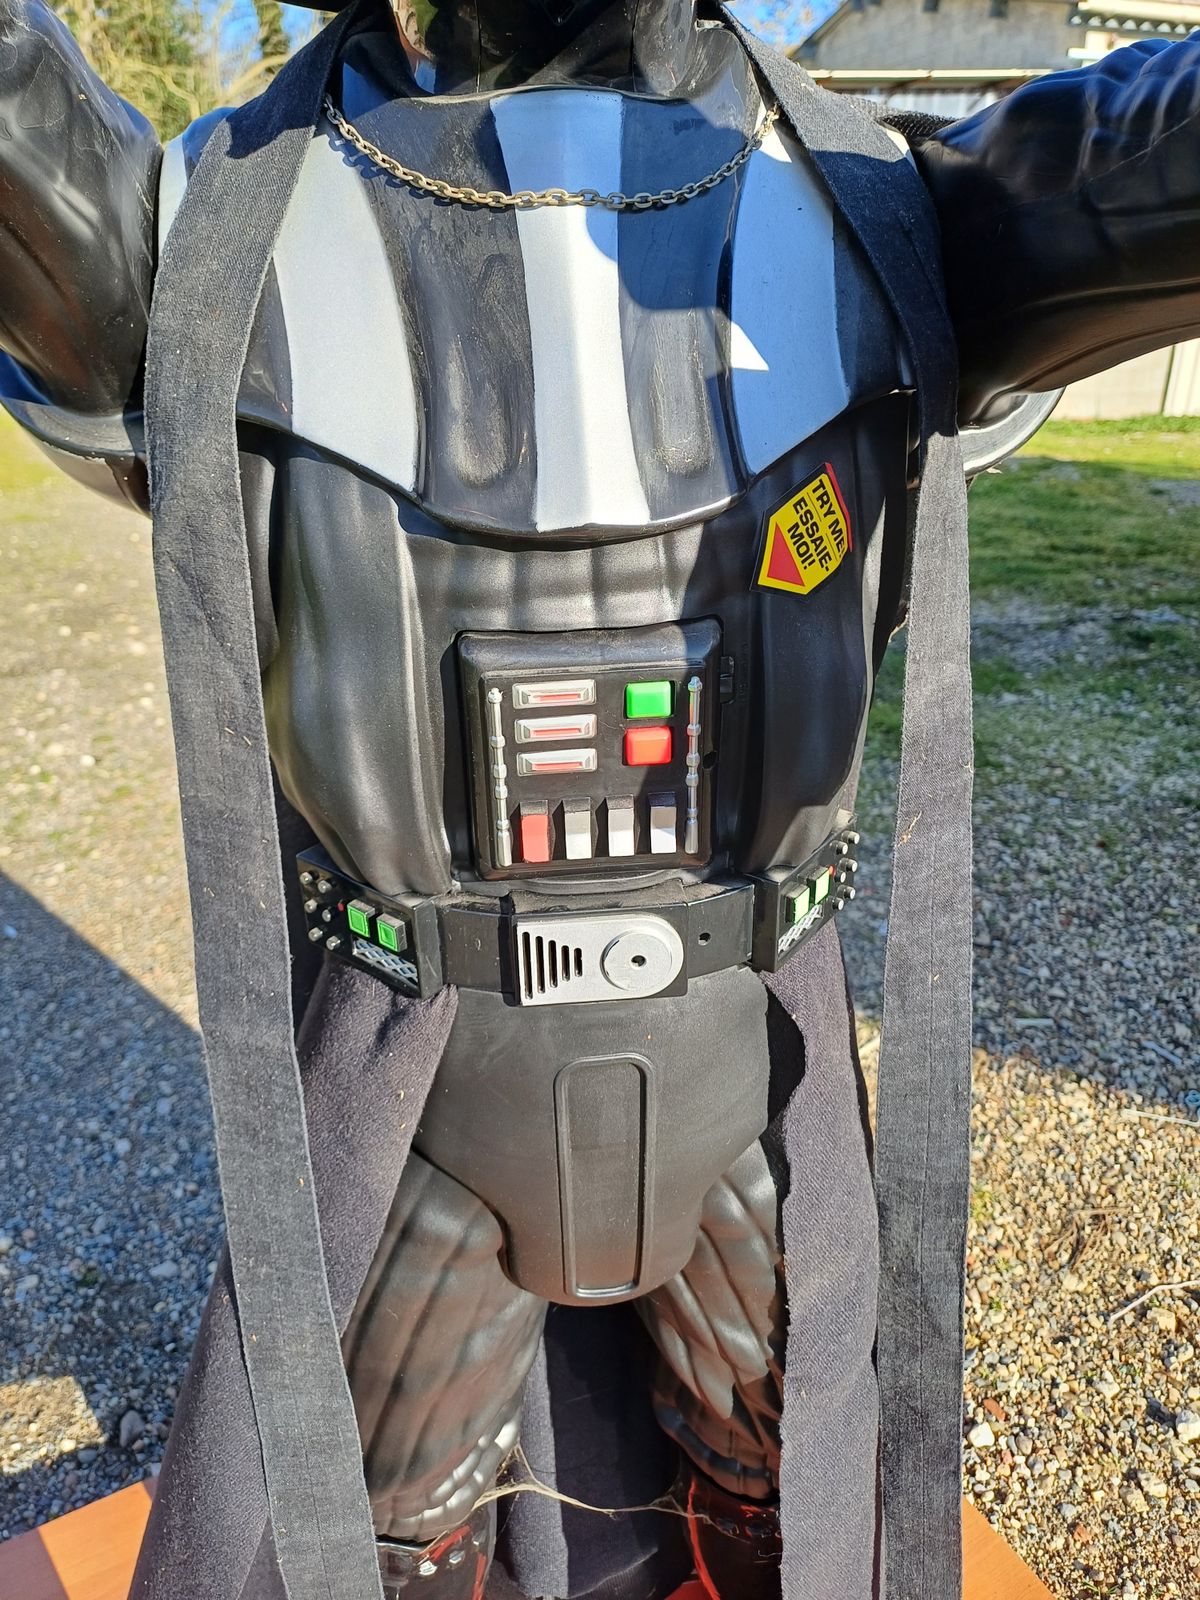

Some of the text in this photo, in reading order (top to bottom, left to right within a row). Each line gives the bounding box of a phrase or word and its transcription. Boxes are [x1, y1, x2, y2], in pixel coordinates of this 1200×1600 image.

[812, 479, 836, 518] TRY
[787, 522, 816, 570] MOI!
[792, 496, 832, 572] ESSAIE-
